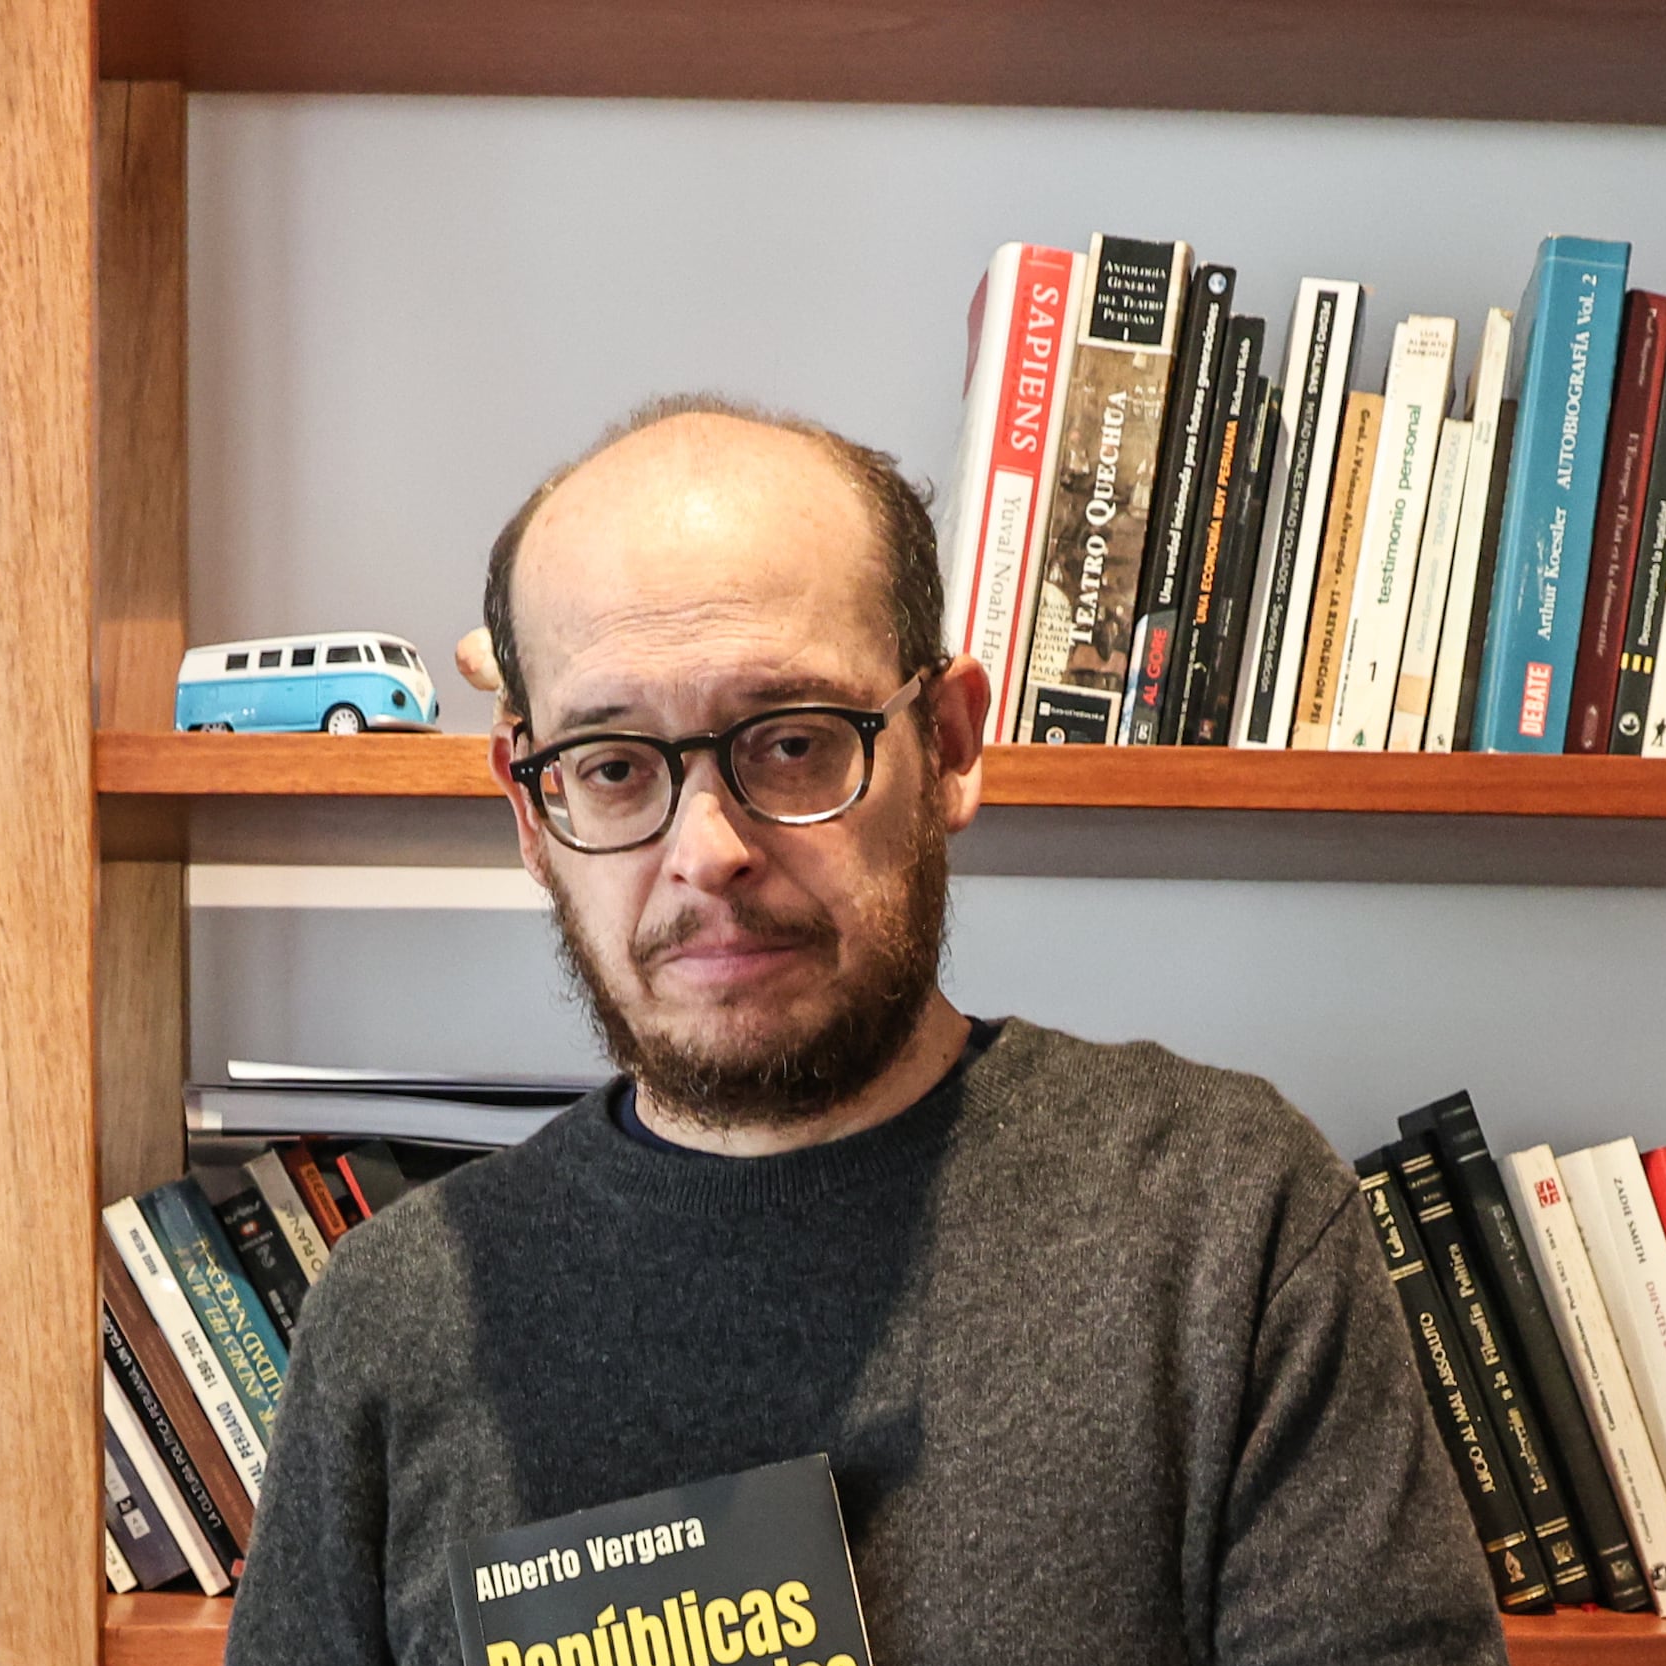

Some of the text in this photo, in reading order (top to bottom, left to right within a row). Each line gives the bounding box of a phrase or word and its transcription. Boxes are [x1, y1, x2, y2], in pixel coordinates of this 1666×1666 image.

[1009, 282, 1059, 452] SAPIENS
[1158, 301, 1222, 604] Una verdad incómoda para futuras generaciones
[1534, 272, 1598, 640] Arthur Koestler AUTOBIOGRAFÍA Vol. 2
[977, 495, 1022, 672] Yuval Noah Har
[1065, 388, 1134, 647] TEATRO QUECHUA
[1375, 403, 1425, 605] testimonio personal
[1143, 628, 1167, 705] AL GORE
[1520, 667, 1548, 733] DEBATE
[1416, 1310, 1498, 1495] JUICIO AL MAL ABSOLUTO
[475, 1517, 706, 1602] Alberto Vergara
